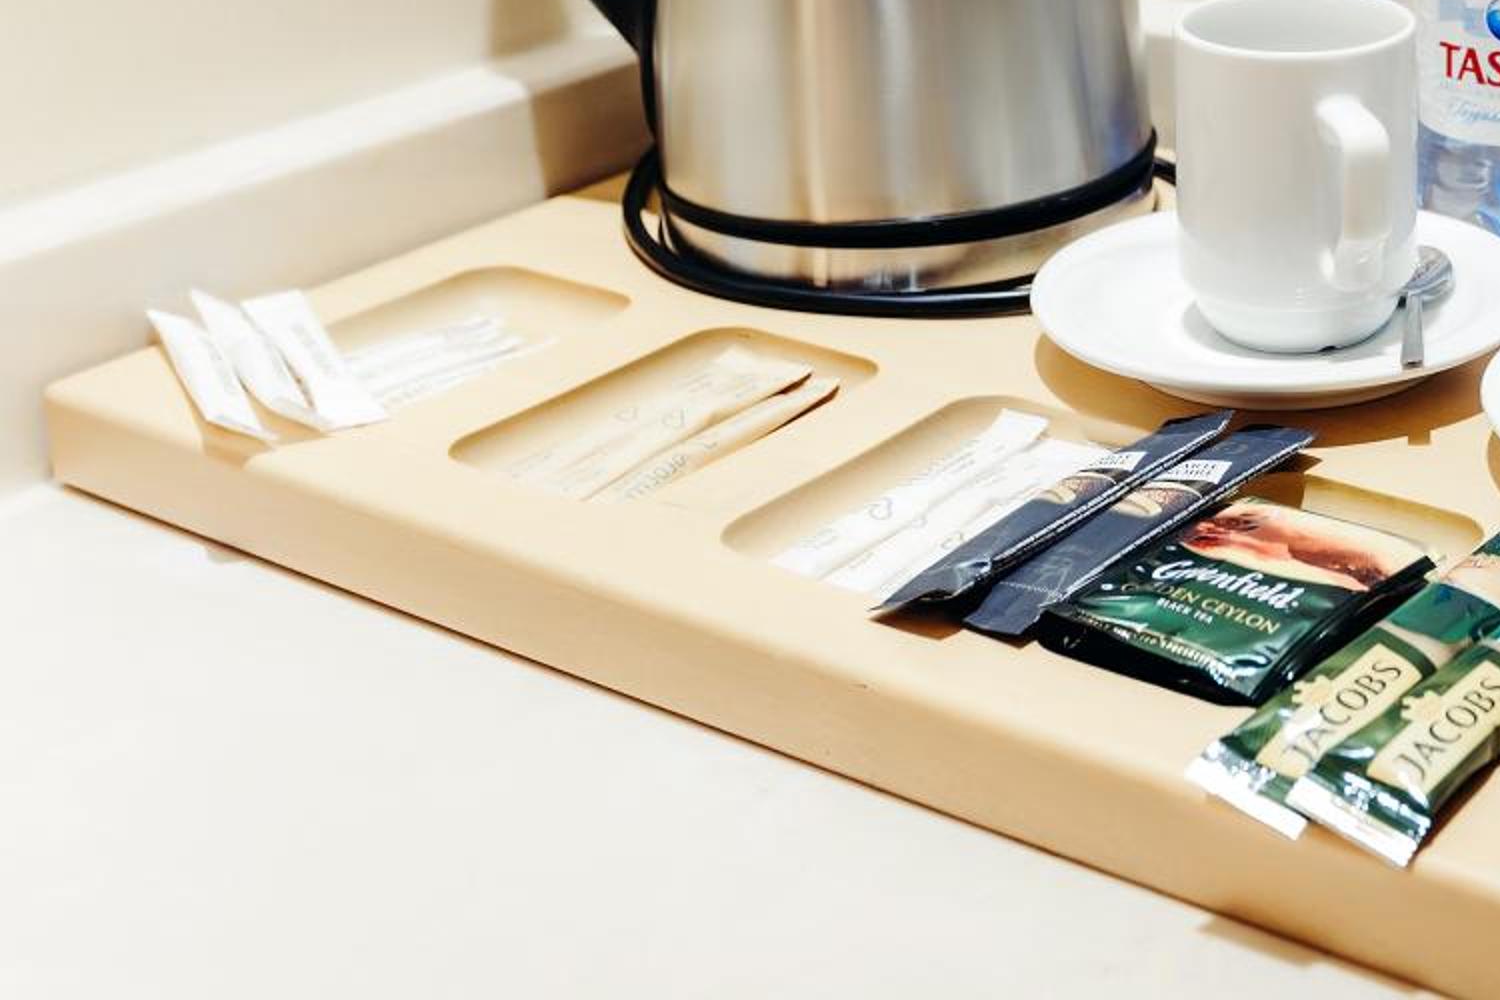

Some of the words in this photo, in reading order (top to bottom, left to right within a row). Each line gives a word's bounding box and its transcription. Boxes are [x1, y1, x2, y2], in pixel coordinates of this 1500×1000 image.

[1121, 581, 1200, 604] GDEN
[1200, 598, 1280, 634] CEYLON
[1152, 560, 1304, 609] Greenfield
[1156, 598, 1192, 615] BLACK
[1193, 610, 1214, 624] TEA
[1284, 659, 1402, 762] JACOBS
